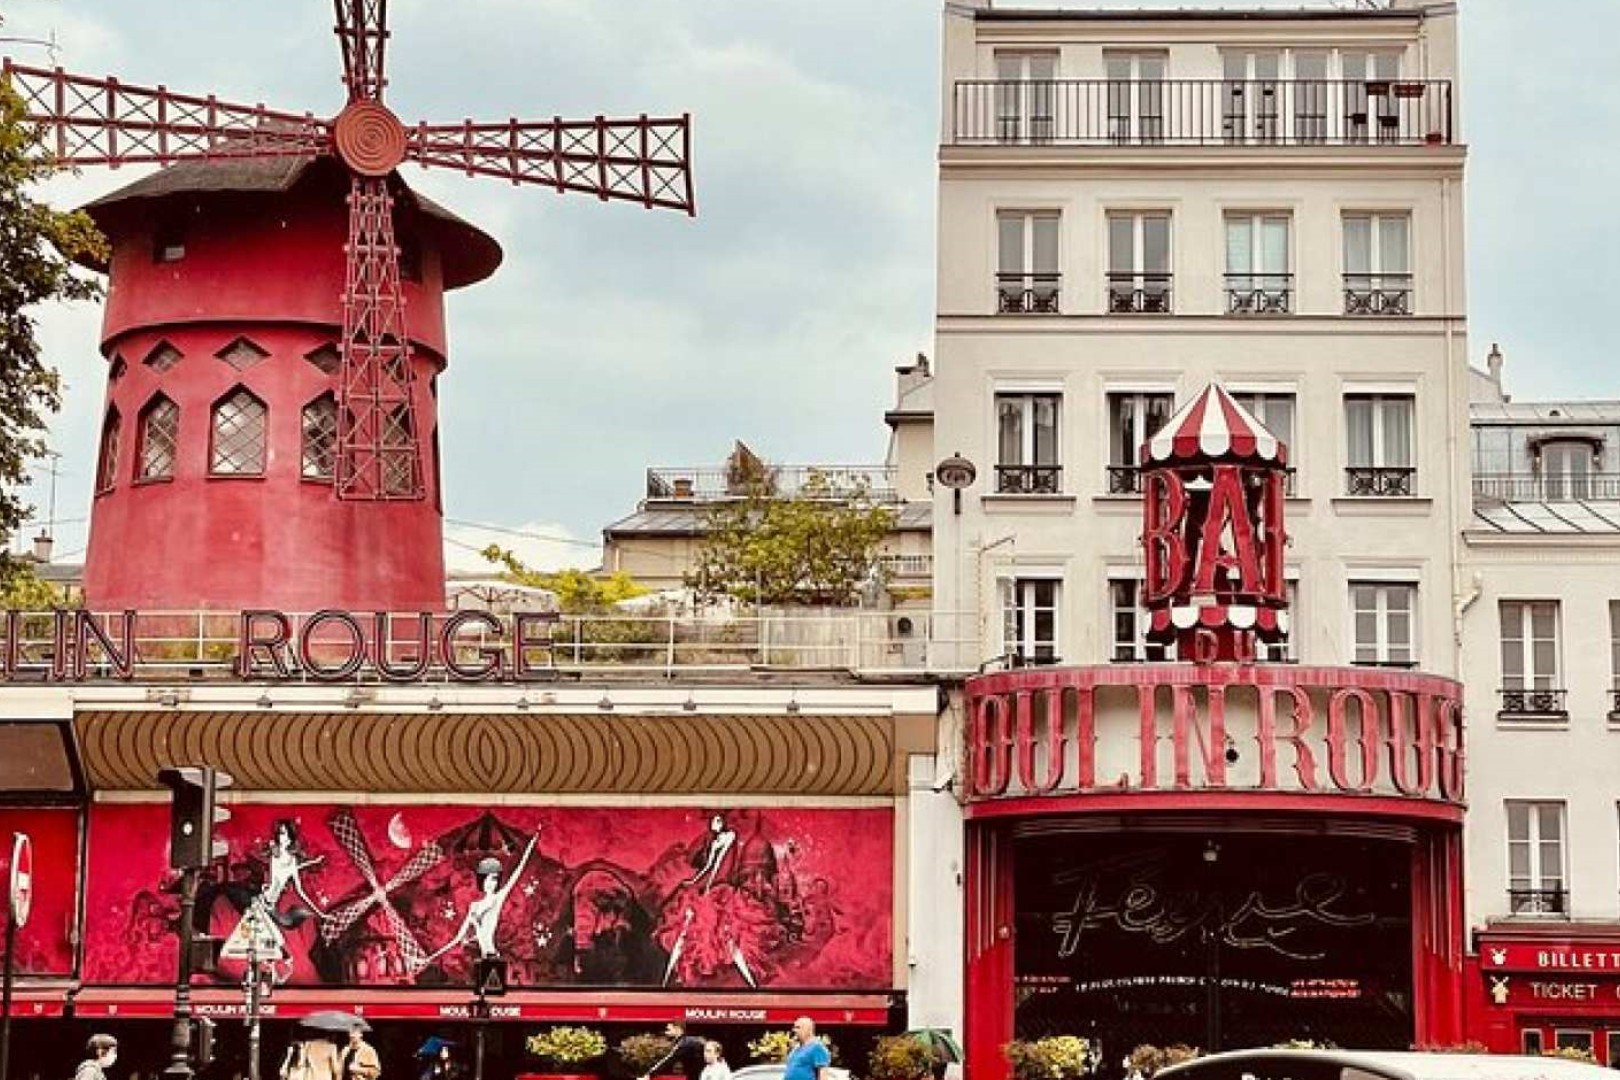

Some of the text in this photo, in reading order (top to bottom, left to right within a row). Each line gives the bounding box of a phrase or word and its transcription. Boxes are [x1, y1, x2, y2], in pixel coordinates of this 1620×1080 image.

[240, 609, 558, 682] ROUGE
[1194, 629, 1257, 663] DU
[964, 684, 1228, 798] OULIN
[1530, 981, 1597, 999] TICKET
[488, 1005, 521, 1017] OUGE
[685, 1008, 767, 1020] MOULIN ROUGE
